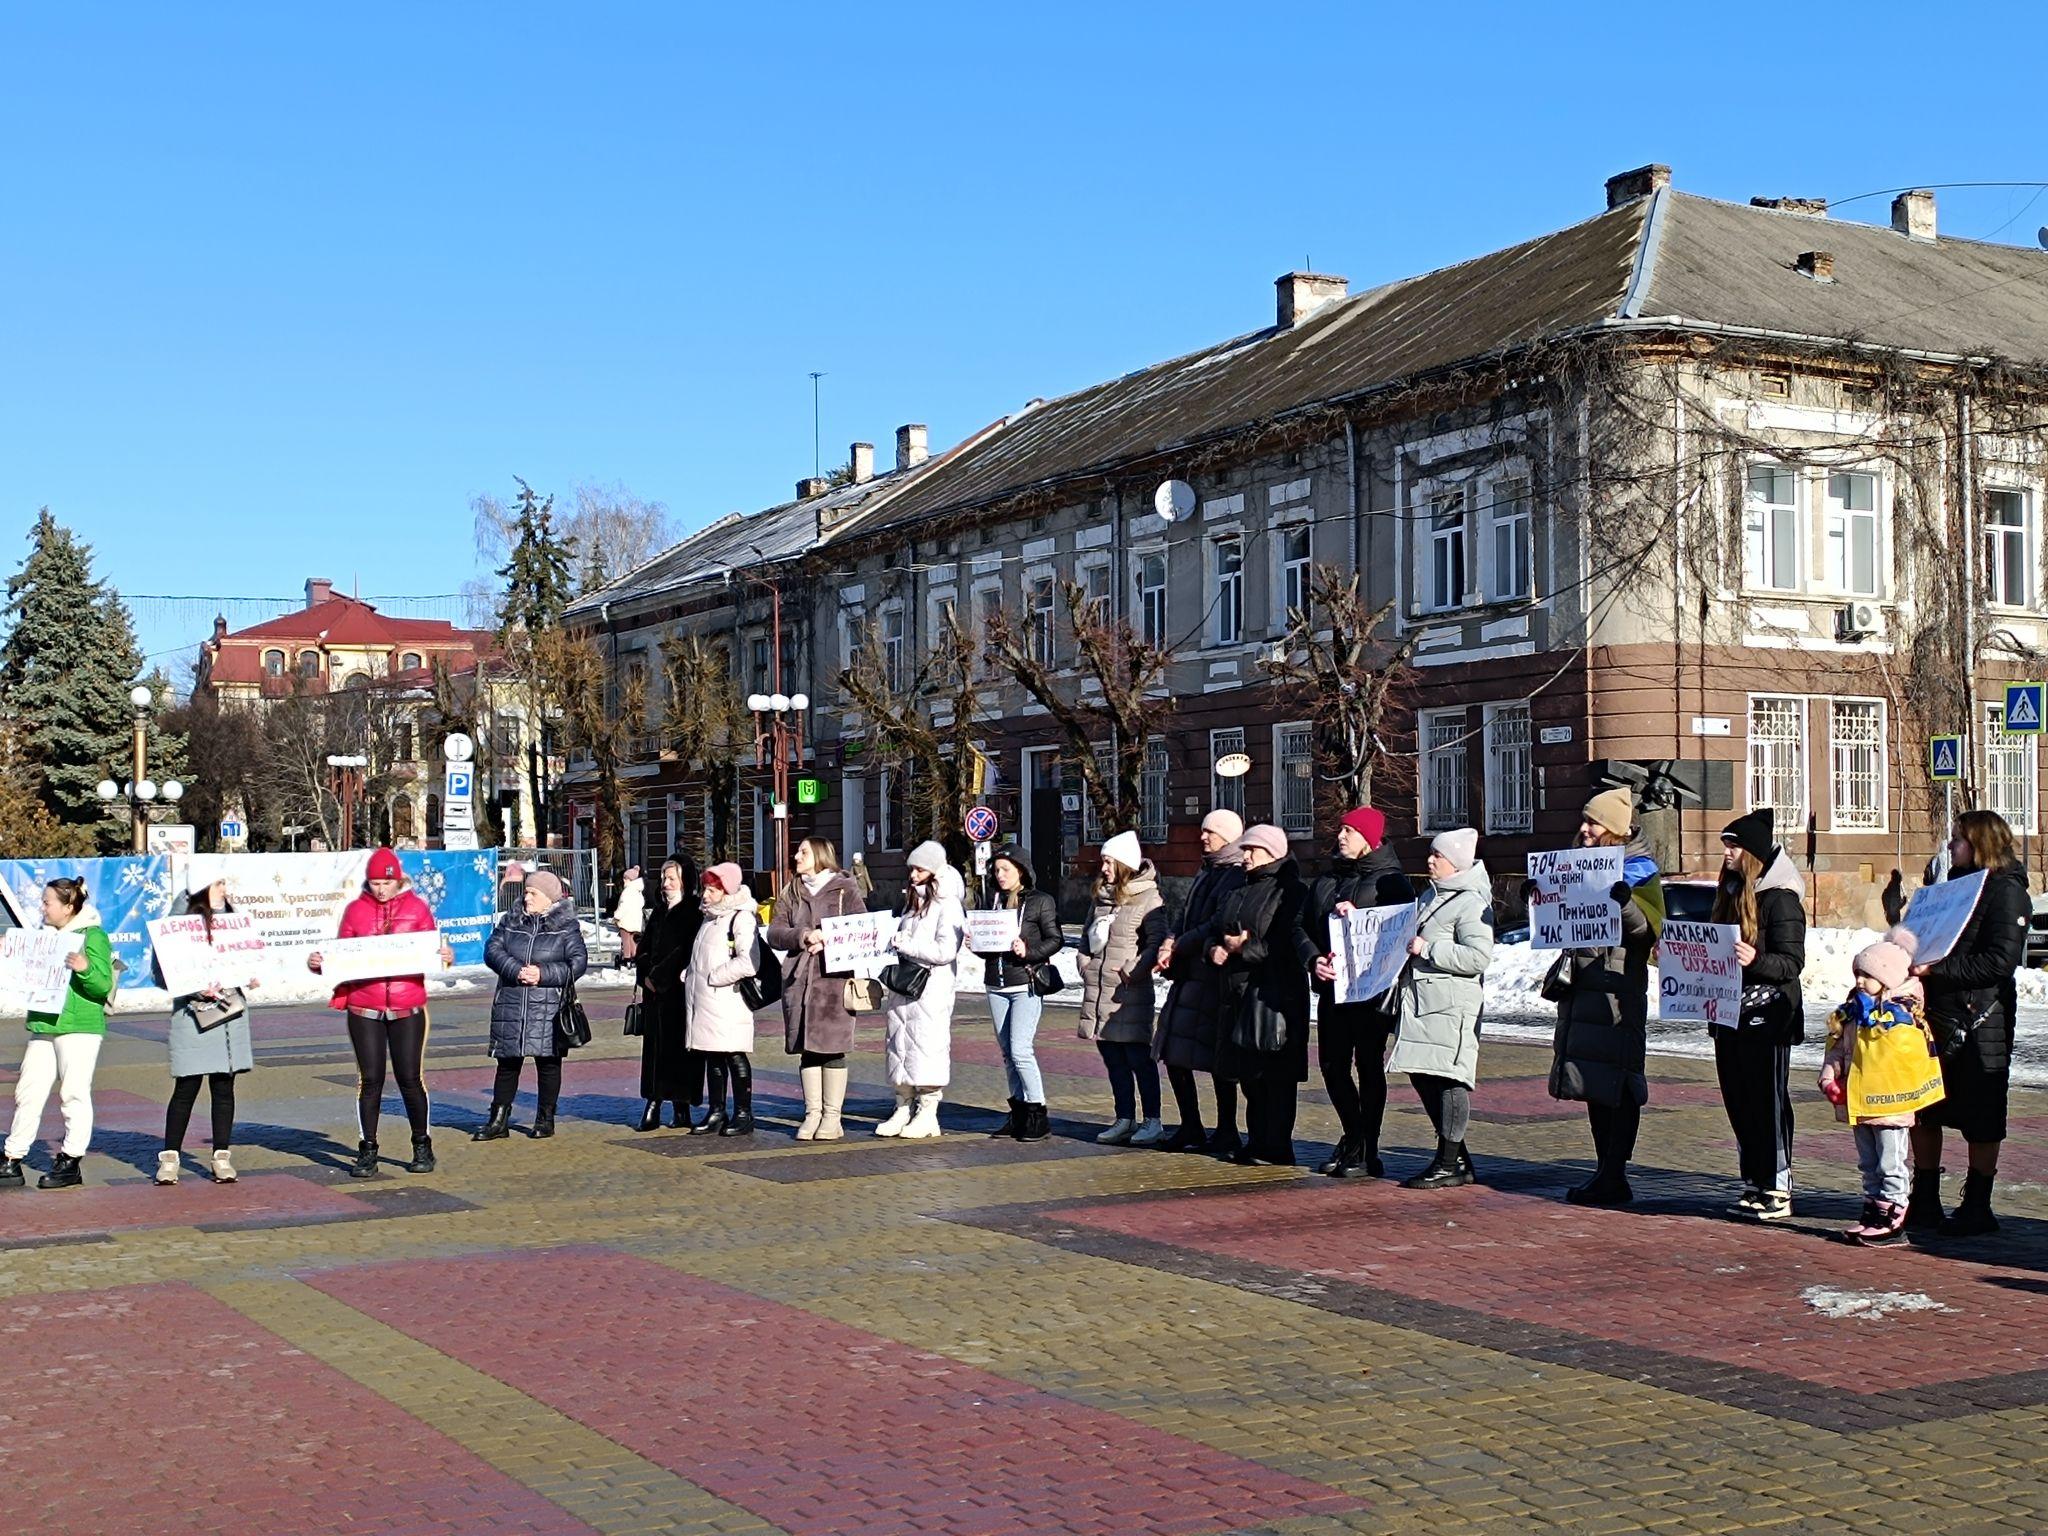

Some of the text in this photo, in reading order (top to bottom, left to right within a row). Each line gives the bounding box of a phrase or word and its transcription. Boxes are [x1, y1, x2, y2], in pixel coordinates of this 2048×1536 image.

[451, 774, 468, 794] P
[1530, 853, 1557, 876] 704
[1576, 857, 1615, 870] ЧОЛОВІК
[1549, 874, 1560, 884] НА
[227, 893, 274, 906] іздвом
[1540, 924, 1562, 944] ЧАС
[1661, 923, 1719, 944] ИМАГАЄМО
[1665, 941, 1708, 958] ТЕРМІНІВ
[1703, 999, 1718, 1022] 18
[1866, 1094, 1896, 1105] ОКРЕМА
